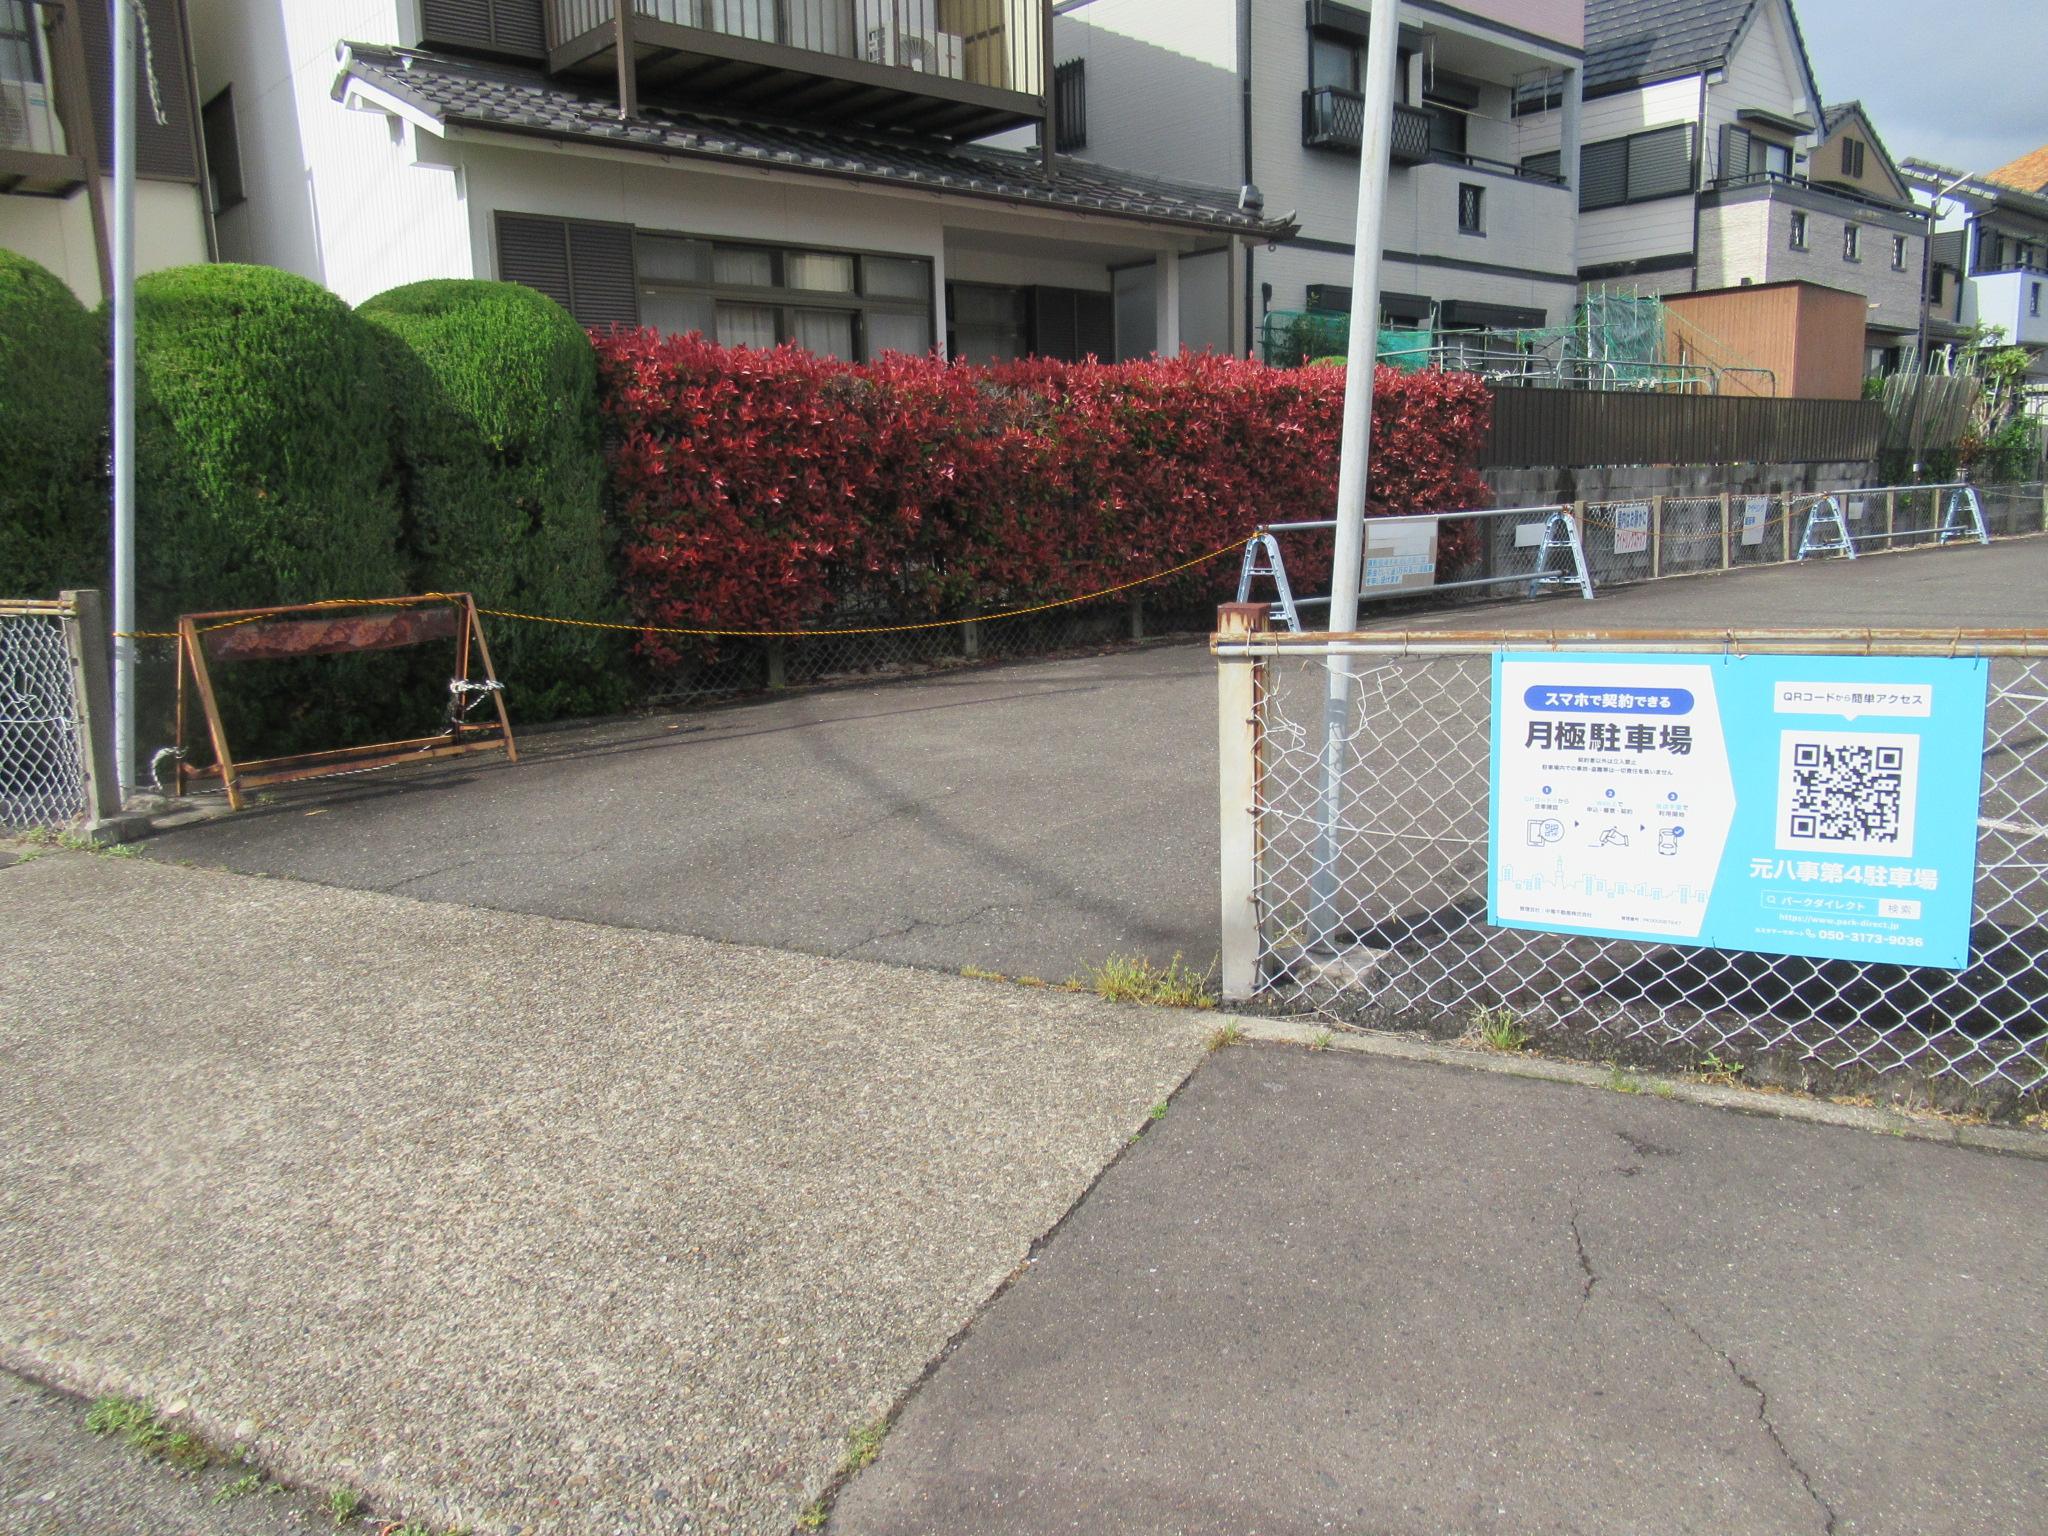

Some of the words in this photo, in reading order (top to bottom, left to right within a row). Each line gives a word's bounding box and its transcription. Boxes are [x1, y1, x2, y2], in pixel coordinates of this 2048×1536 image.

[1545, 693, 1671, 709] スマホで契約できる
[1783, 692, 1923, 705] QRコードから簡単アクセス
[1525, 721, 1692, 755] 月極駐車場
[1750, 858, 1938, 890] 元八事第4駐車場
[1782, 896, 1866, 911] パークダイレクト
[1779, 913, 1900, 930] https://www.park-direct.jp
[1819, 930, 1925, 948] 050-3173-9036
